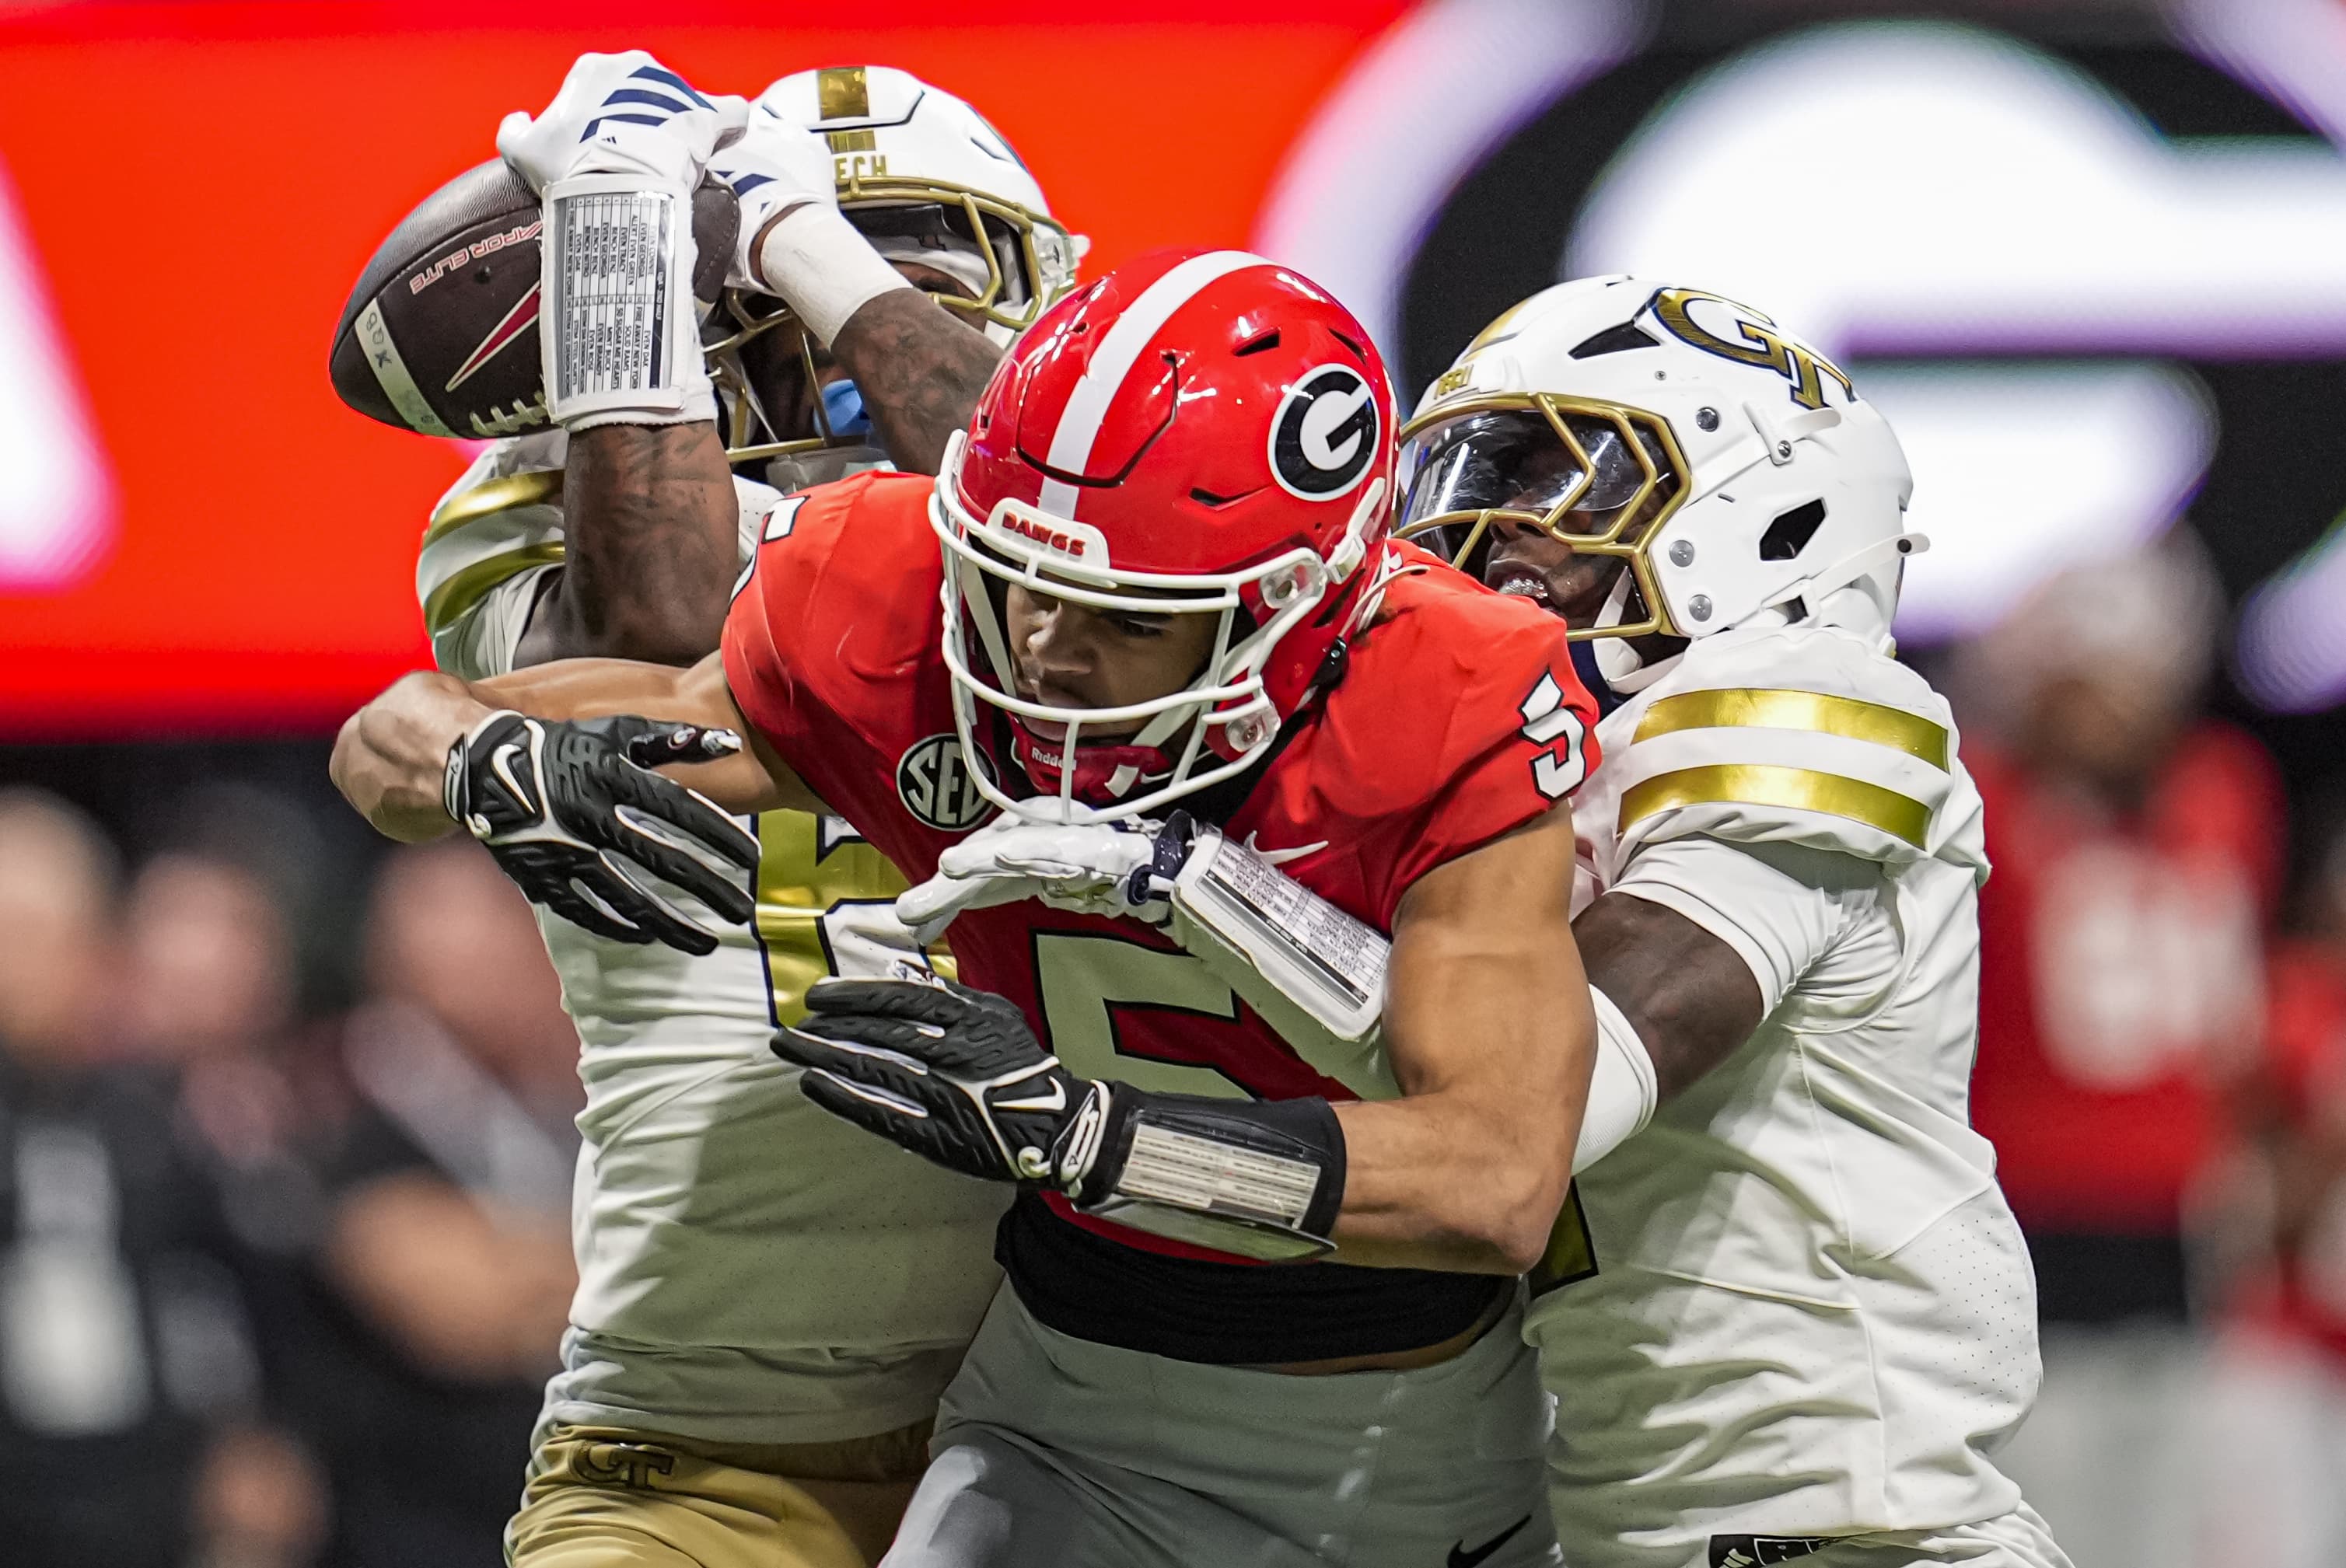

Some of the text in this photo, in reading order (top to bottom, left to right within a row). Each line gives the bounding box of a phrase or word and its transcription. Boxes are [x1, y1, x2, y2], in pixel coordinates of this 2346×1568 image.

[834, 155, 887, 182] ECH
[409, 248, 470, 295] ELITE
[1275, 369, 1377, 494] G
[1002, 510, 1086, 557] DAWGS
